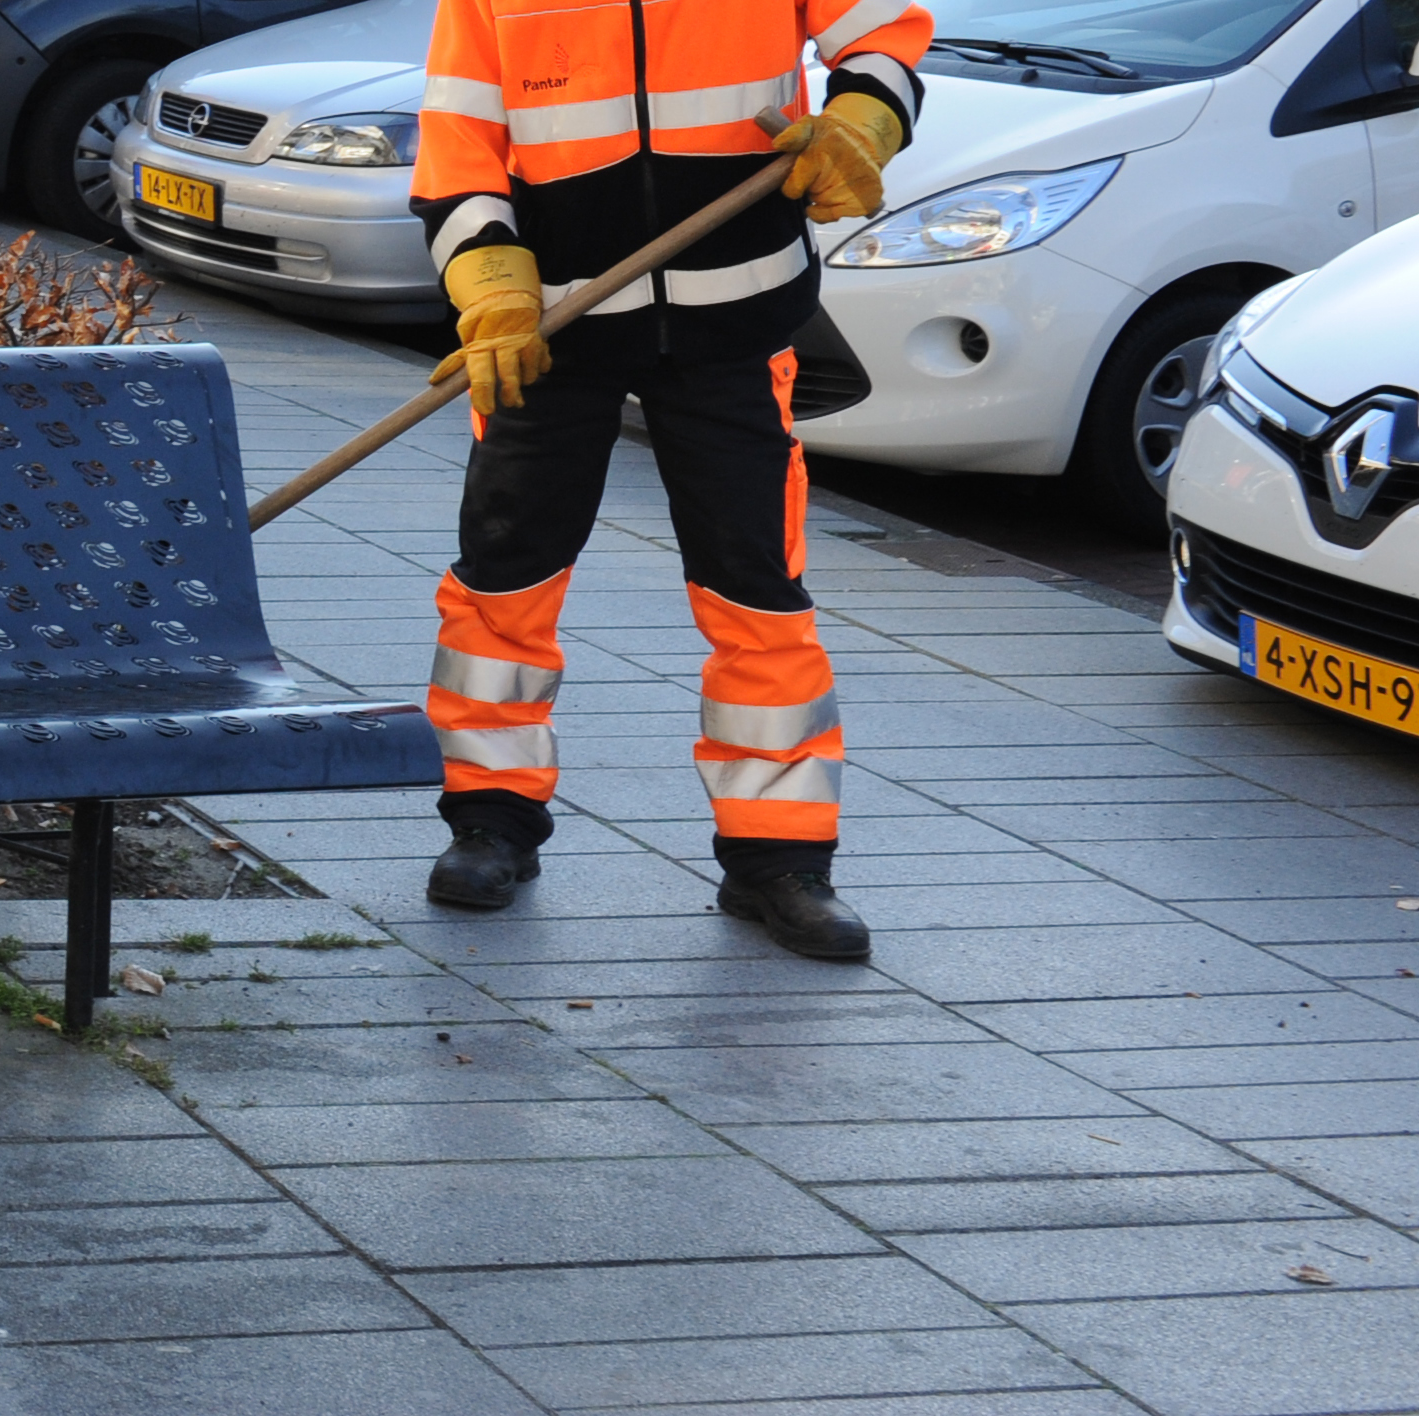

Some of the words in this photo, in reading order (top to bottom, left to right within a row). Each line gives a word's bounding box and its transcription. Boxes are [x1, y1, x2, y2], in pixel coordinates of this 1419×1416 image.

[522, 77, 569, 92] Pantar
[147, 172, 206, 215] 14-LX-TX
[1266, 636, 1419, 722] 4-XSH-9
